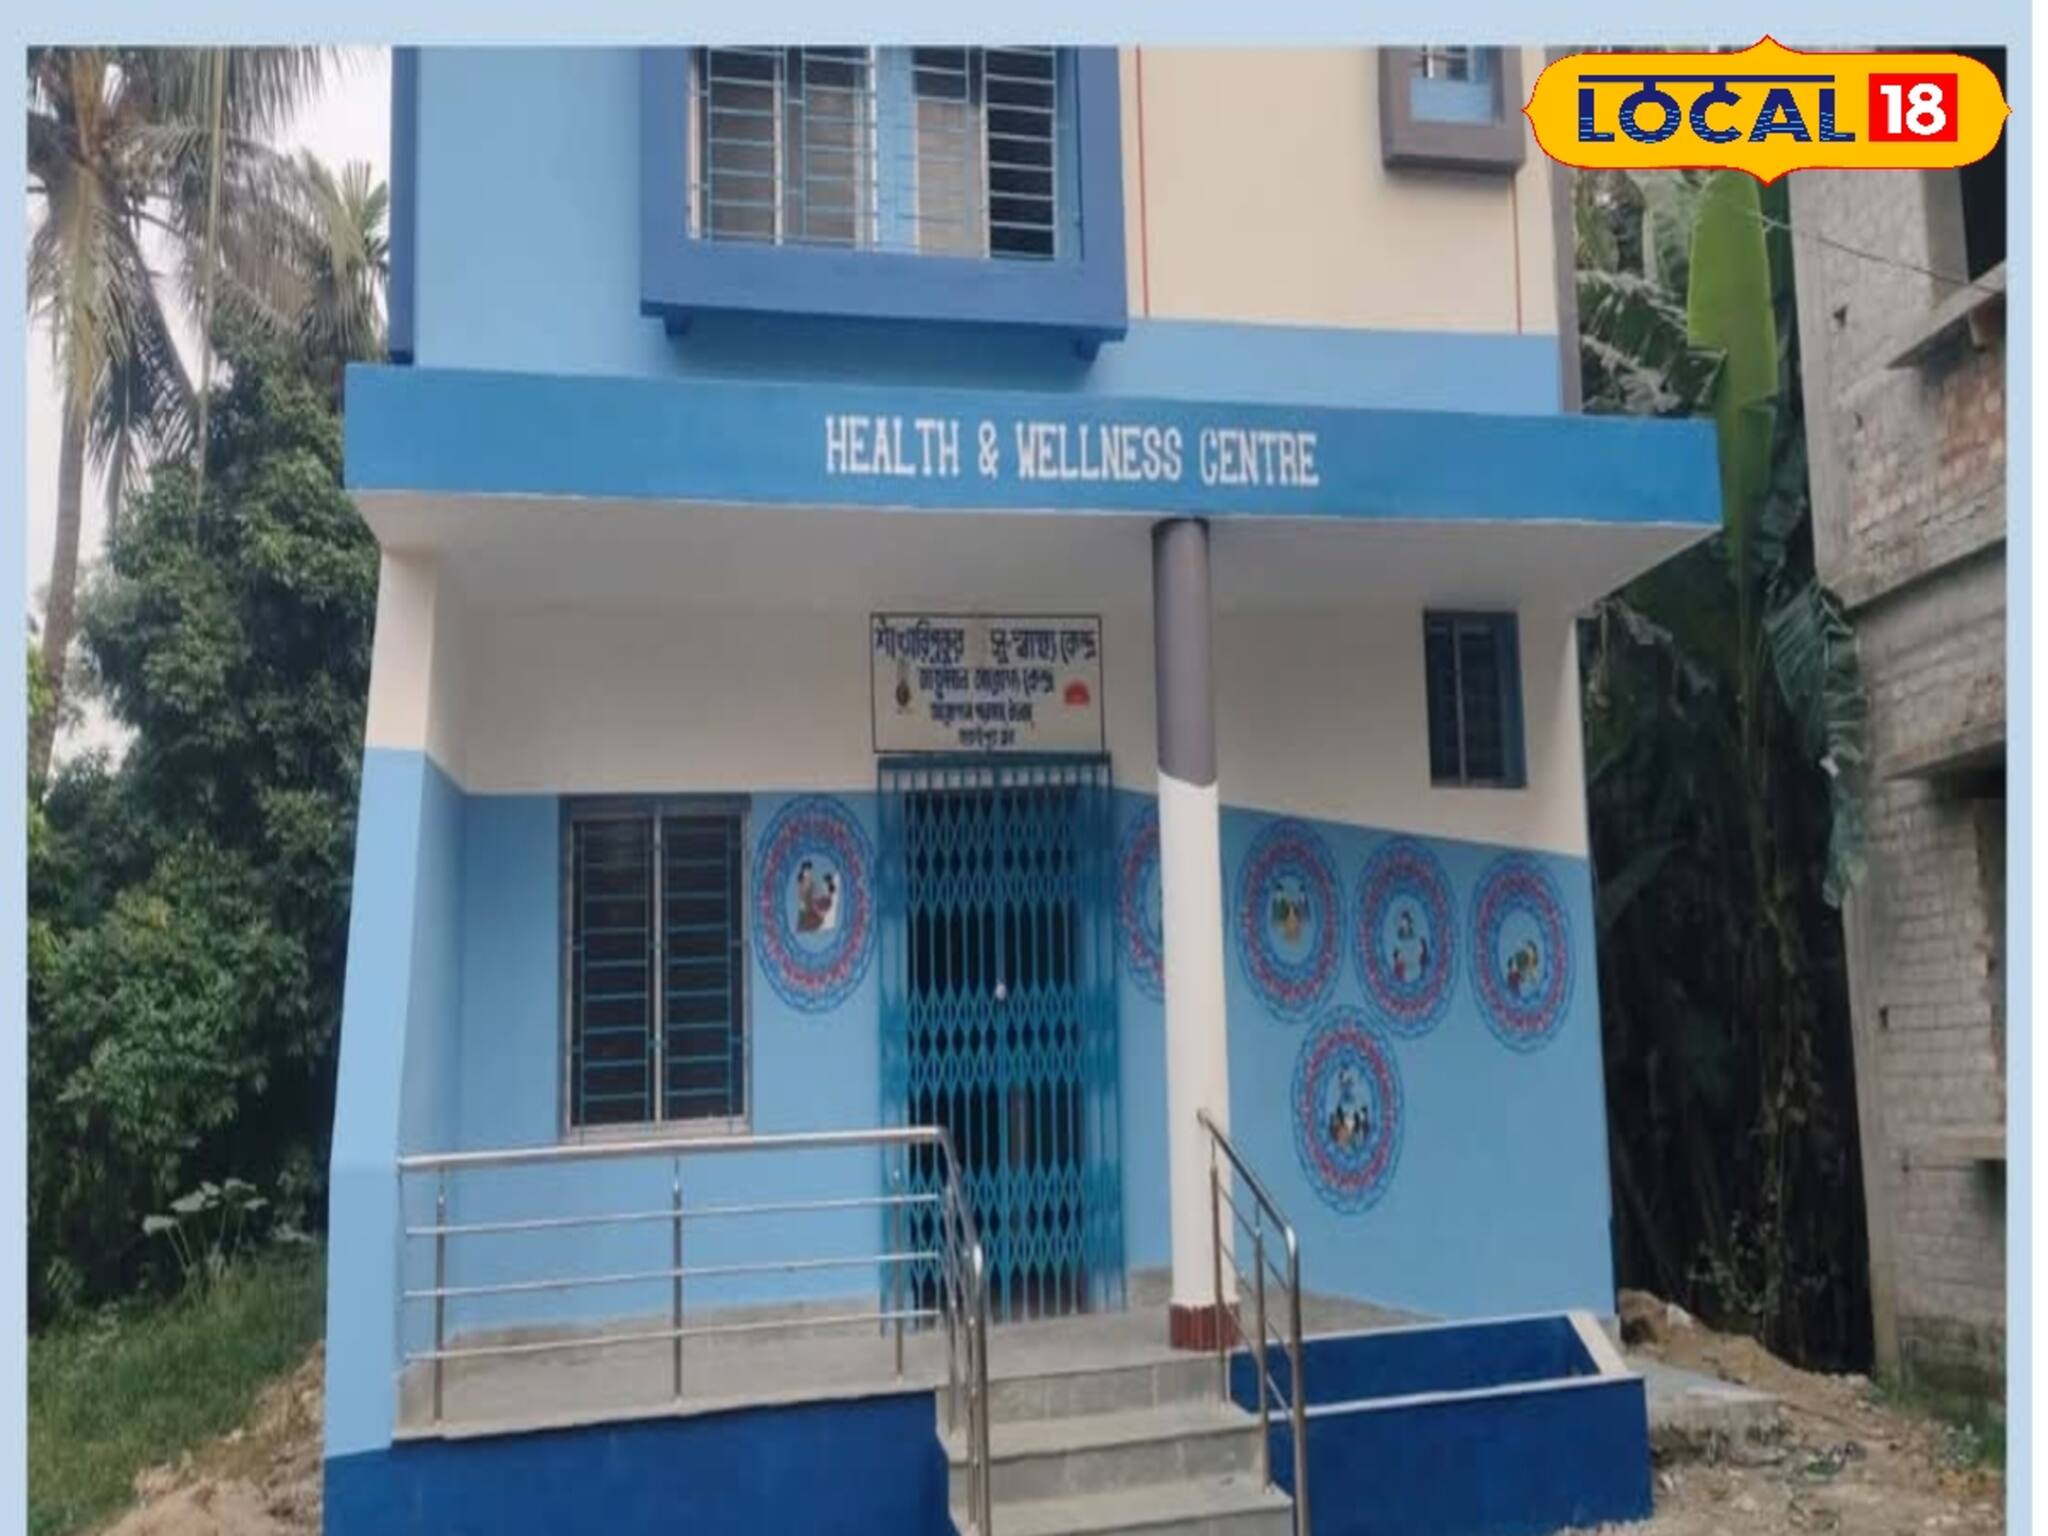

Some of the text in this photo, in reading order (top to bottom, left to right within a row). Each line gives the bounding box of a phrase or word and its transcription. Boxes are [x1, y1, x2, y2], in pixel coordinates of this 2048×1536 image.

[825, 415, 1321, 487] HEALTH & WELLNESS CENTRE
